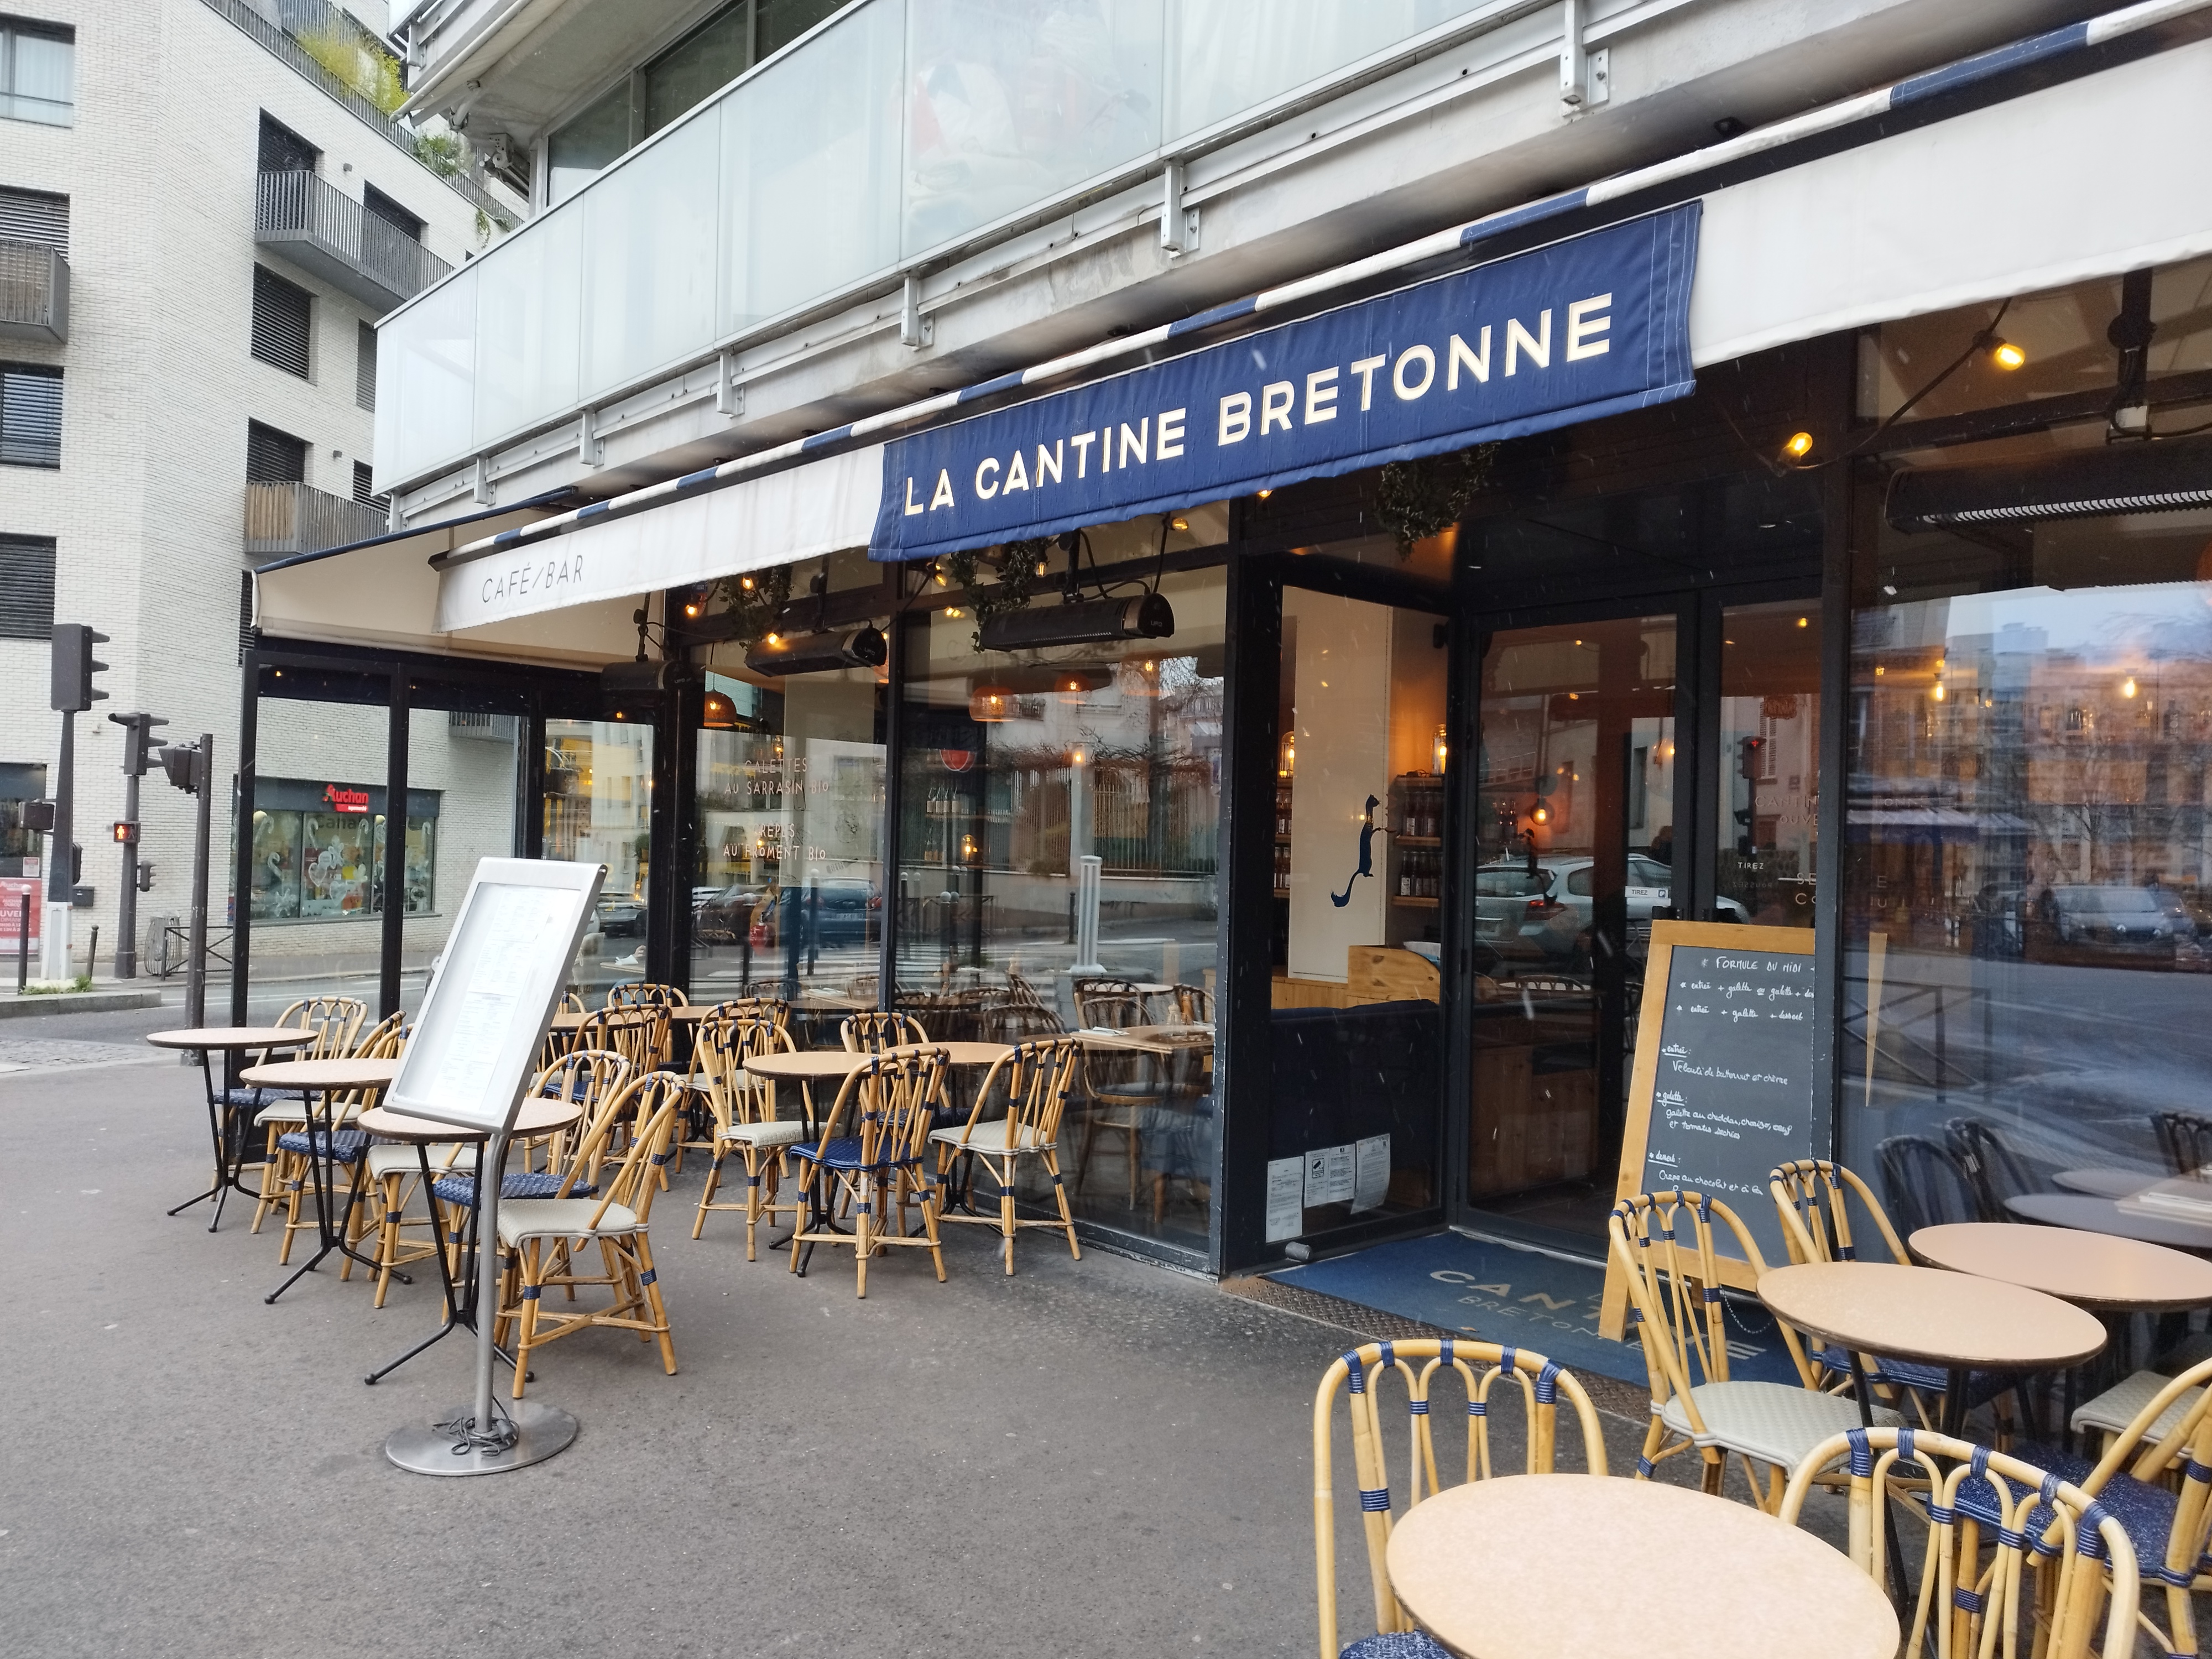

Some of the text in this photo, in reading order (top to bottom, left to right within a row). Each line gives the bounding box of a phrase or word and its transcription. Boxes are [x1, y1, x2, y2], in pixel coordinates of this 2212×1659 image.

[905, 293, 1612, 515] LA CANTINE BRETONNE
[482, 555, 582, 603] CAFÉ/BAR
[325, 784, 368, 804] Auchan
[725, 780, 828, 795] AU SARRASIN BIO
[723, 844, 826, 861] AU FROMENT BIO
[1738, 862, 1764, 870] TIREZ
[1716, 956, 1758, 970] FORMULE
[1767, 961, 1778, 971] DU
[1726, 982, 1752, 999] galette
[1768, 985, 1793, 1001] galette
[1732, 1008, 1759, 1022] galette
[1704, 1067, 1714, 1077] de
[1666, 1108, 1691, 1119] galette
[1693, 1110, 1705, 1119] au
[1682, 1121, 1712, 1133] tomates
[1682, 1175, 1693, 1183] au
[1694, 1176, 1726, 1189] chocolat
[1729, 1183, 1739, 1192] et
[1741, 1185, 1749, 1193] à
